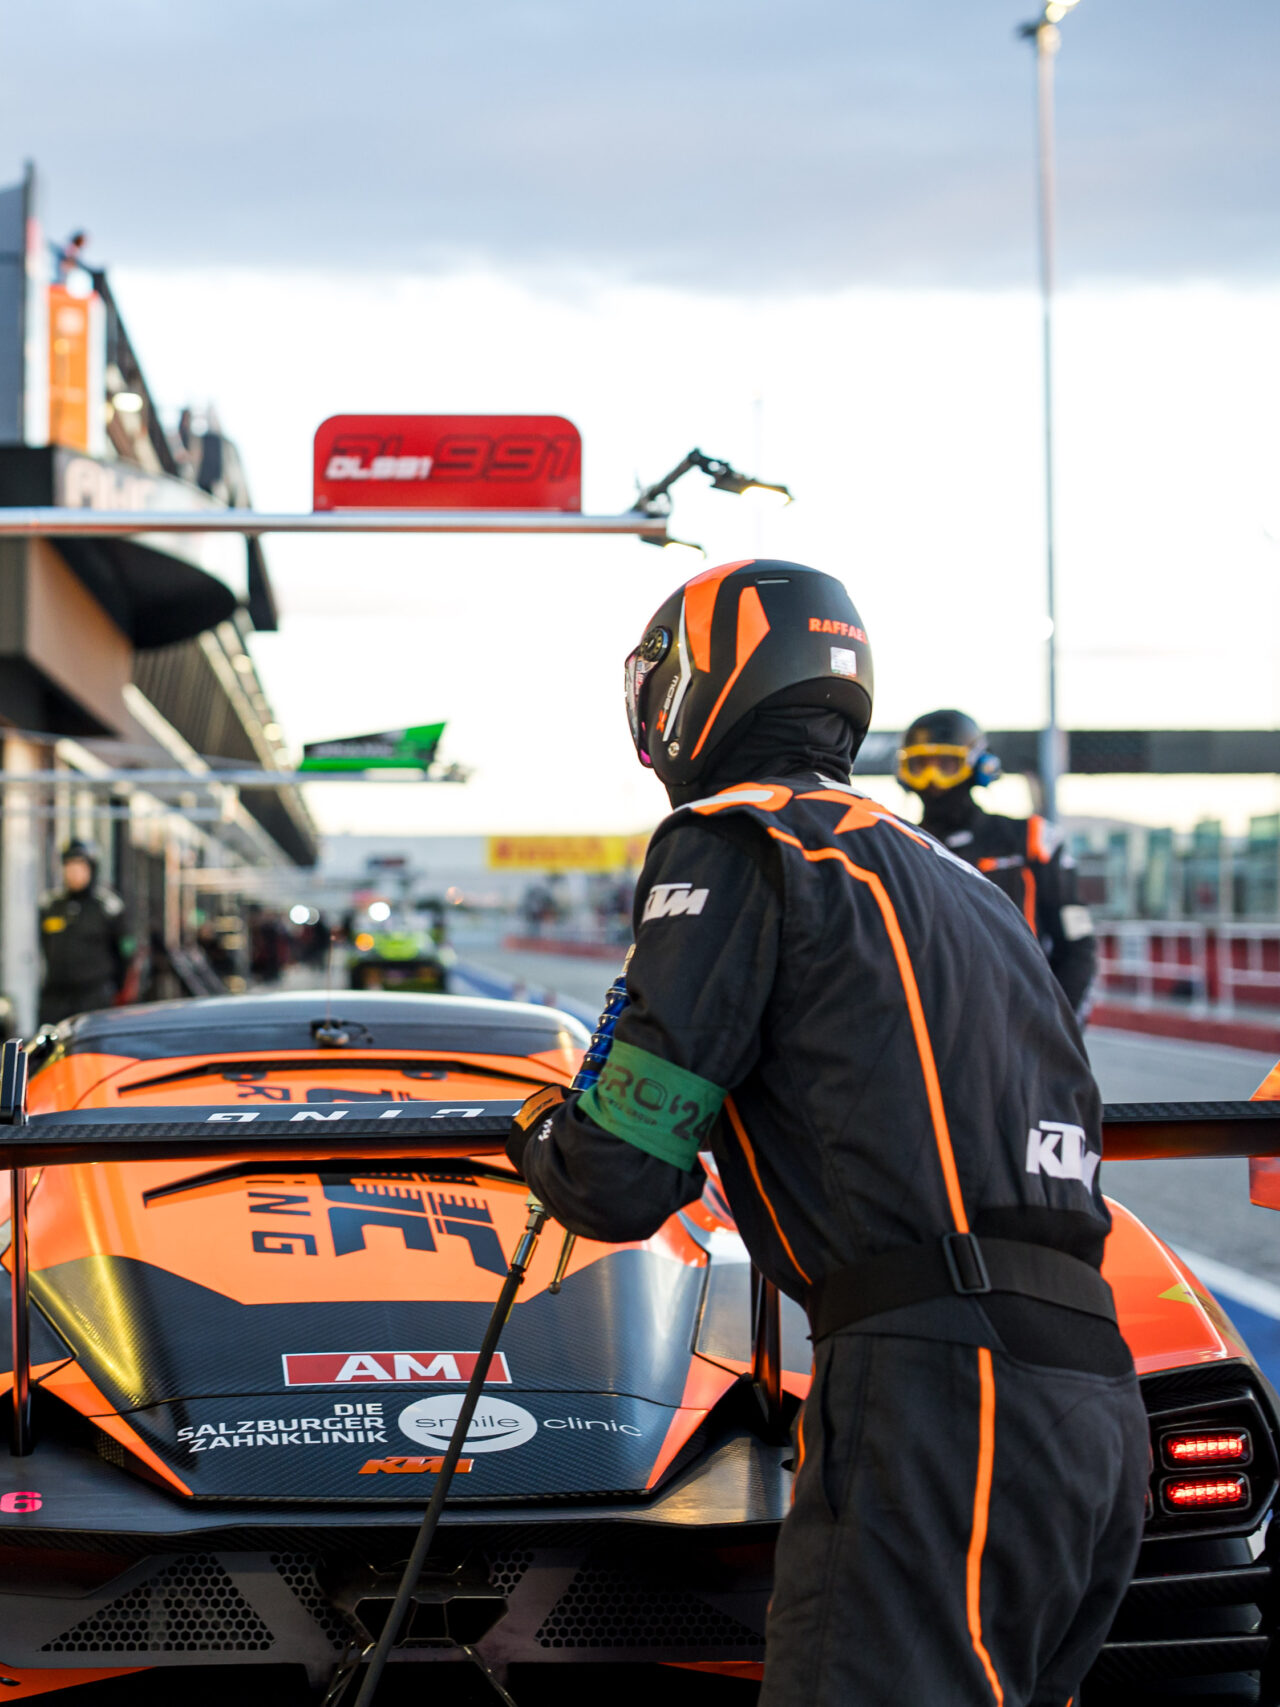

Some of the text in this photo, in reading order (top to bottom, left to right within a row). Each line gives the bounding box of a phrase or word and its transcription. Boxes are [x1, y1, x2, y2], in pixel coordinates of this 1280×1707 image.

[335, 1354, 462, 1381] AM
[334, 1403, 384, 1416] DIE
[177, 1417, 386, 1442] SALZBURGER
[543, 1416, 643, 1437] clinic
[189, 1430, 388, 1453] ZAHNKLINIK
[358, 1456, 475, 1474] KTM
